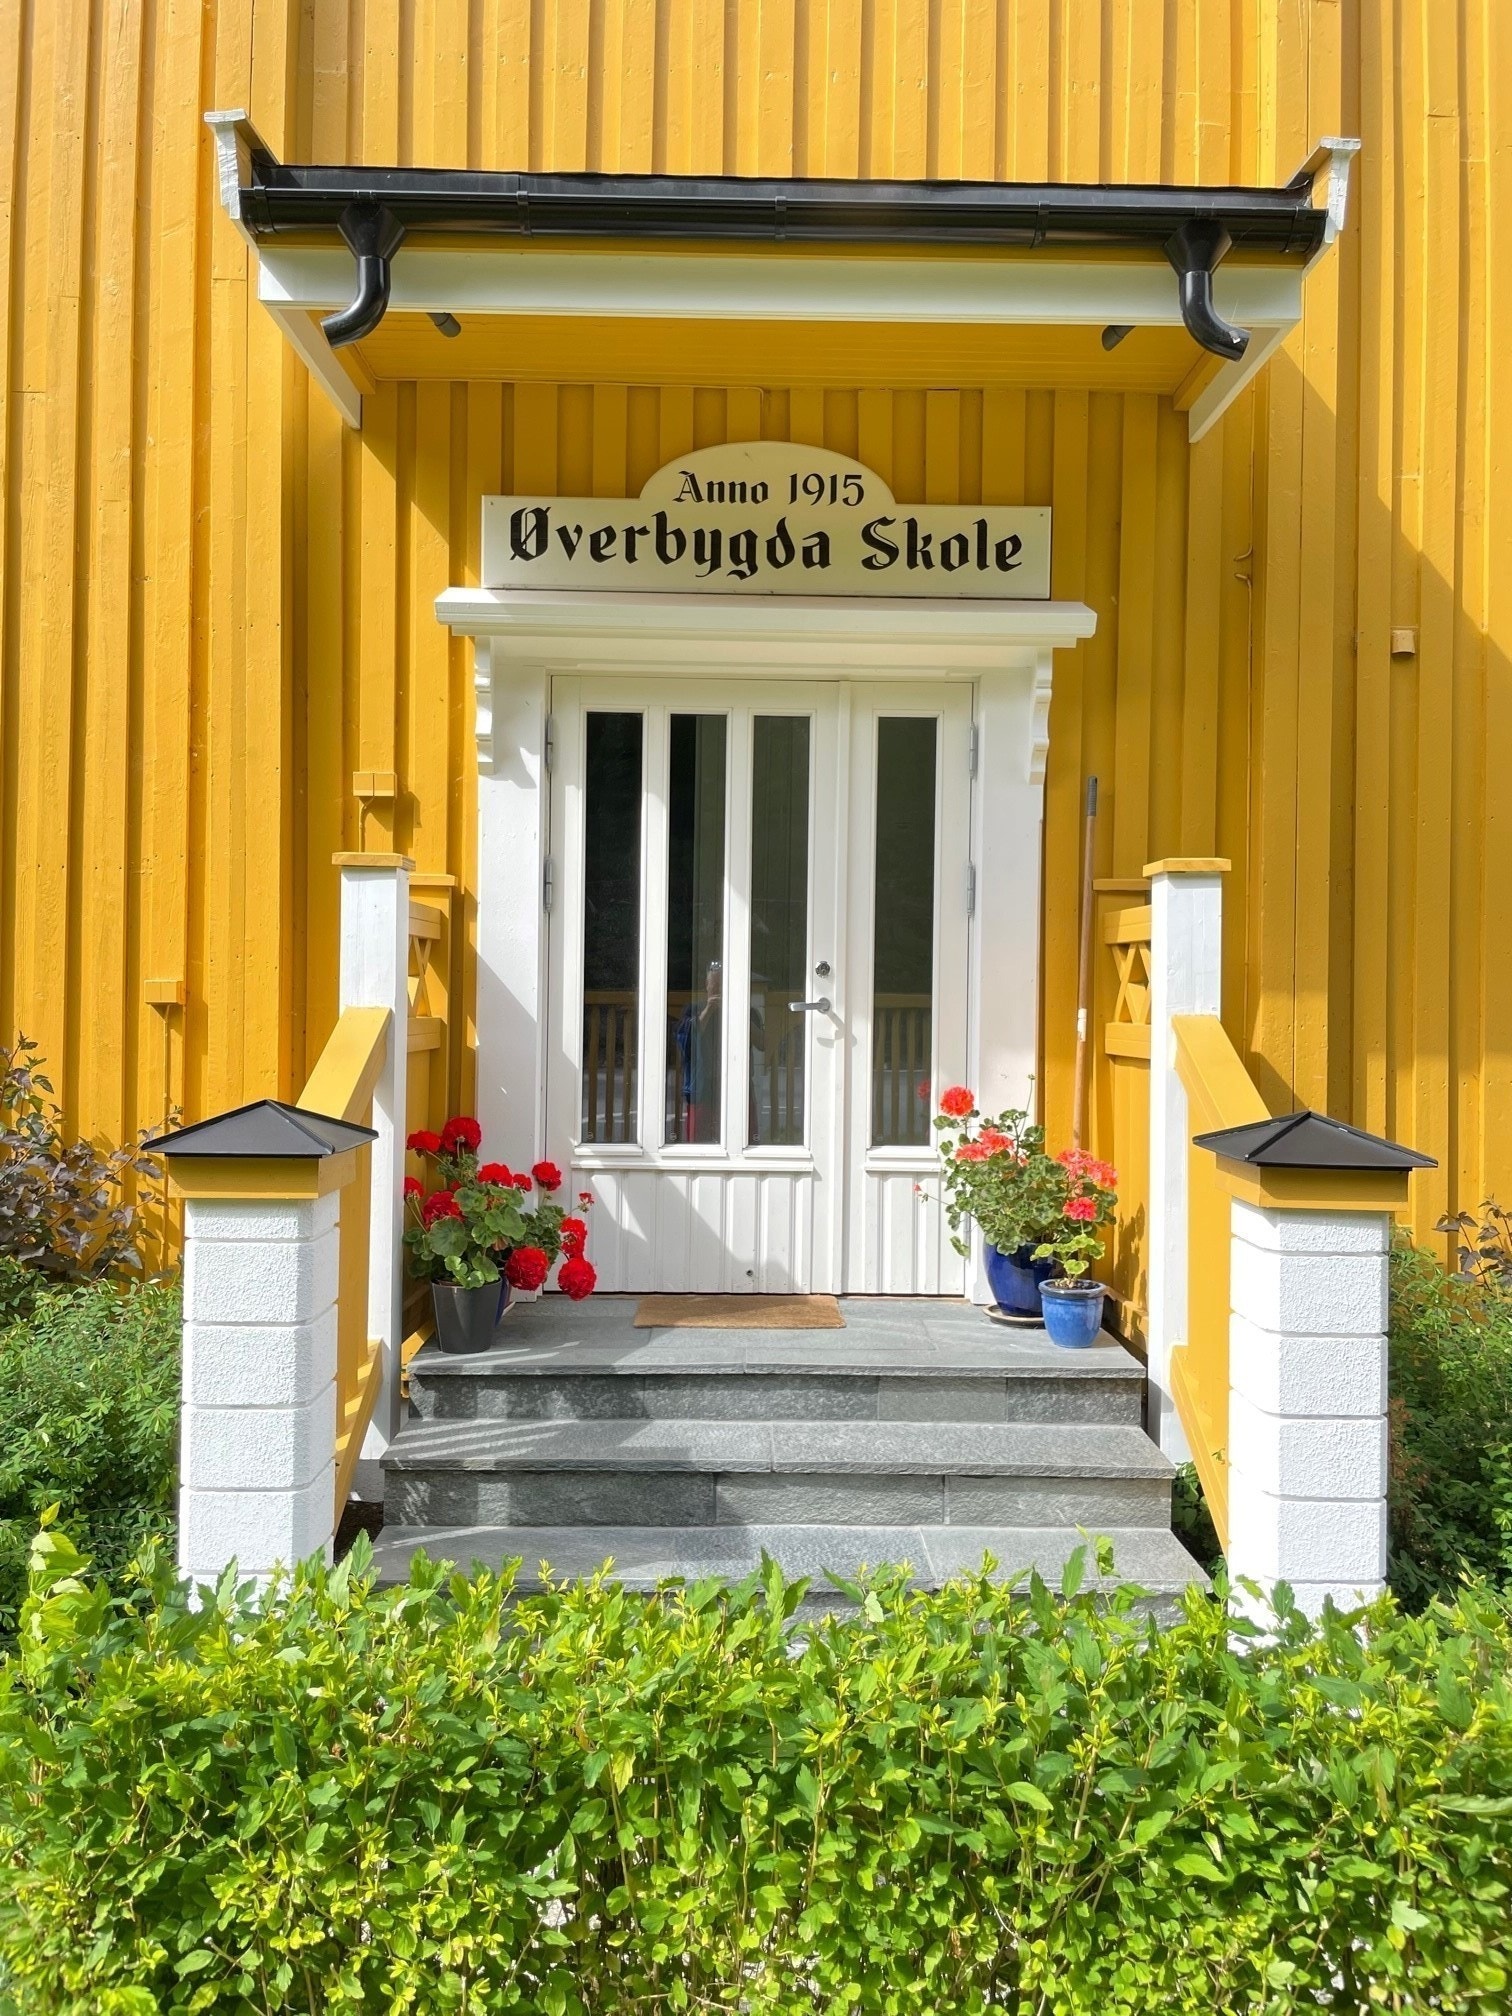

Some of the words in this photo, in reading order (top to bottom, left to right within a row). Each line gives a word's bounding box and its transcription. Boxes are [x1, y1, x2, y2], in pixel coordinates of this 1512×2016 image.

[672, 470, 769, 505] Anno
[788, 473, 865, 508] 1915
[510, 506, 832, 581] Øverbygda
[861, 516, 1023, 573] Skole
